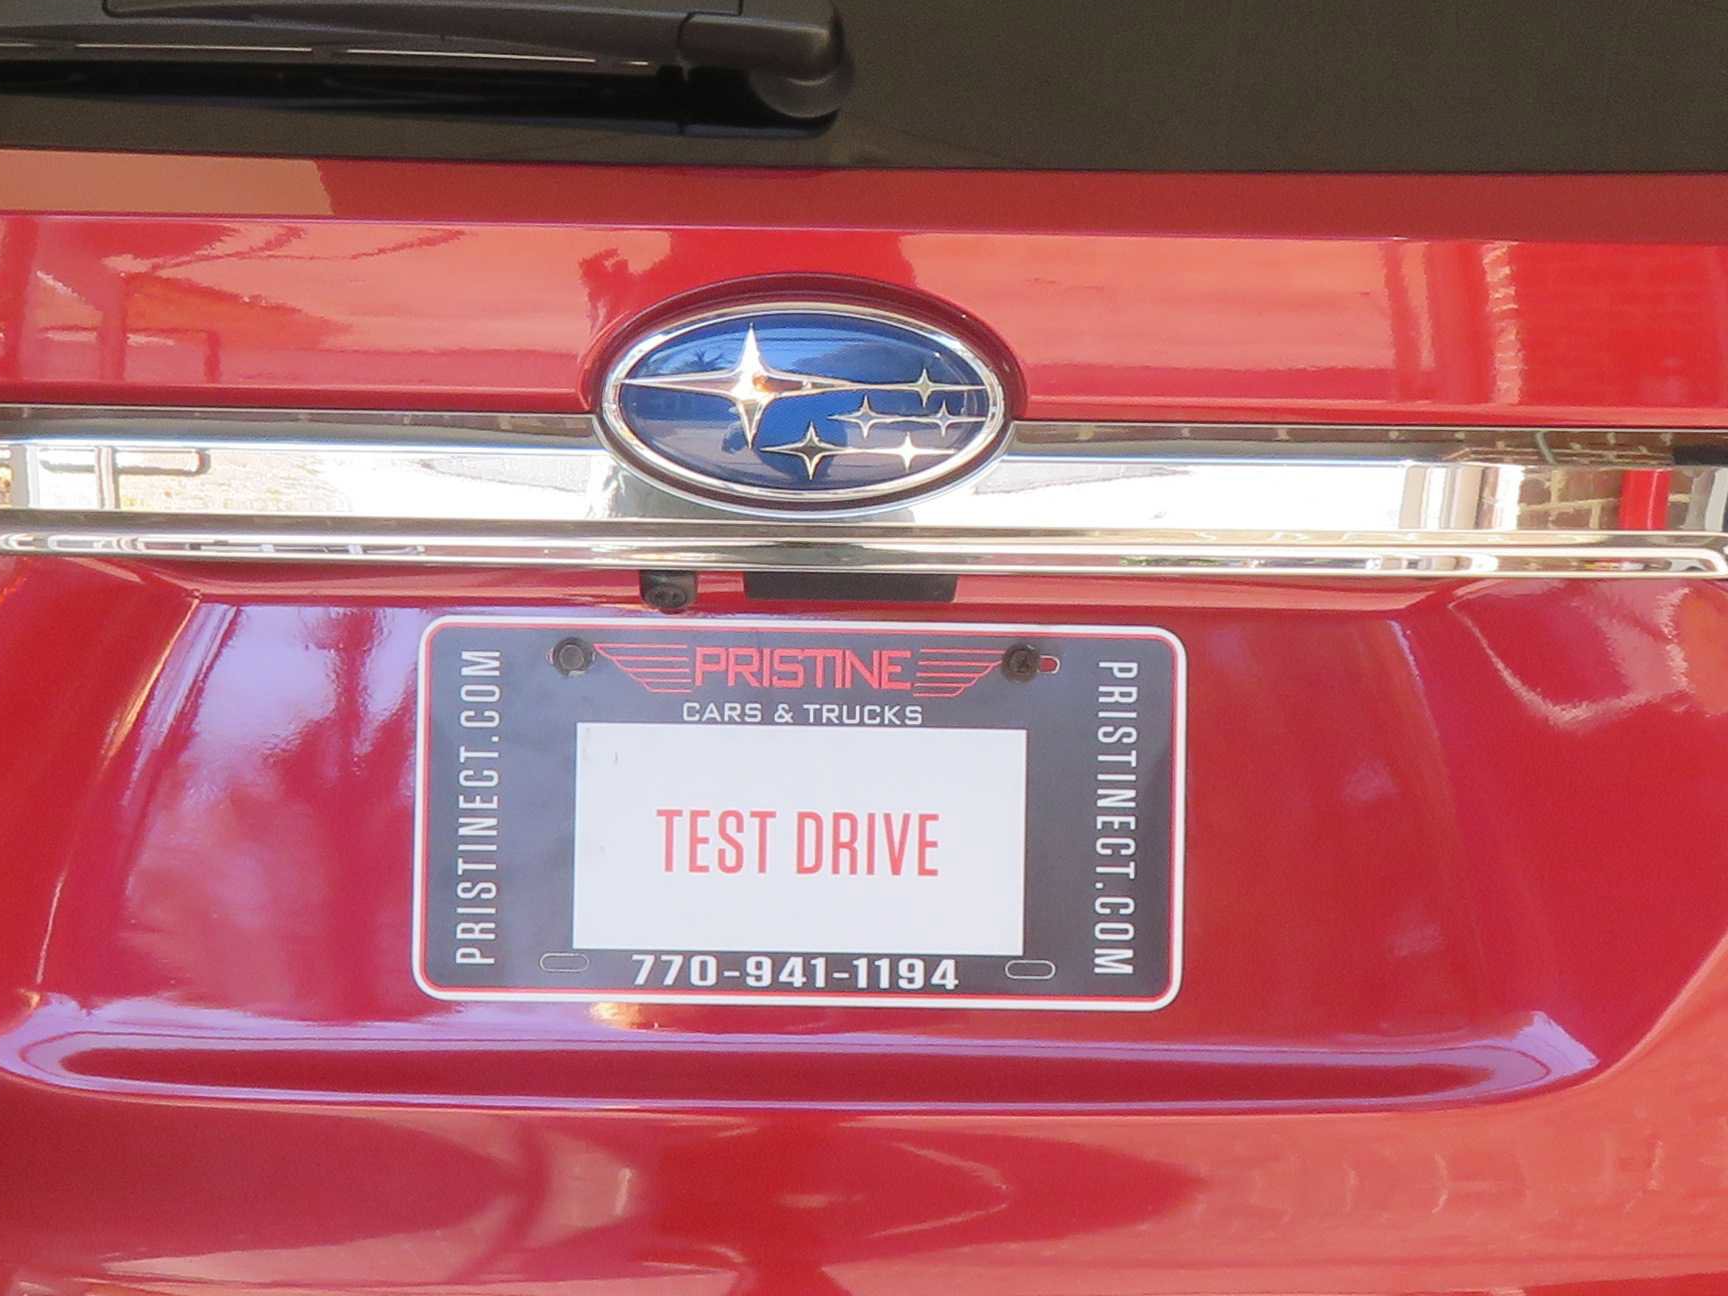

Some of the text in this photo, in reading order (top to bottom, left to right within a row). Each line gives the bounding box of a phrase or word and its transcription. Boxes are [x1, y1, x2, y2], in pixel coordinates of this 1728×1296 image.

[694, 646, 912, 690] PRISTINE
[682, 702, 923, 725] CARS & TRUCKS
[456, 649, 501, 965] PRISTINECT.COM
[1094, 661, 1138, 975] PRISTINECT.COM
[657, 810, 939, 875] TEST DRIVE
[632, 954, 959, 989] 770-941-1194
